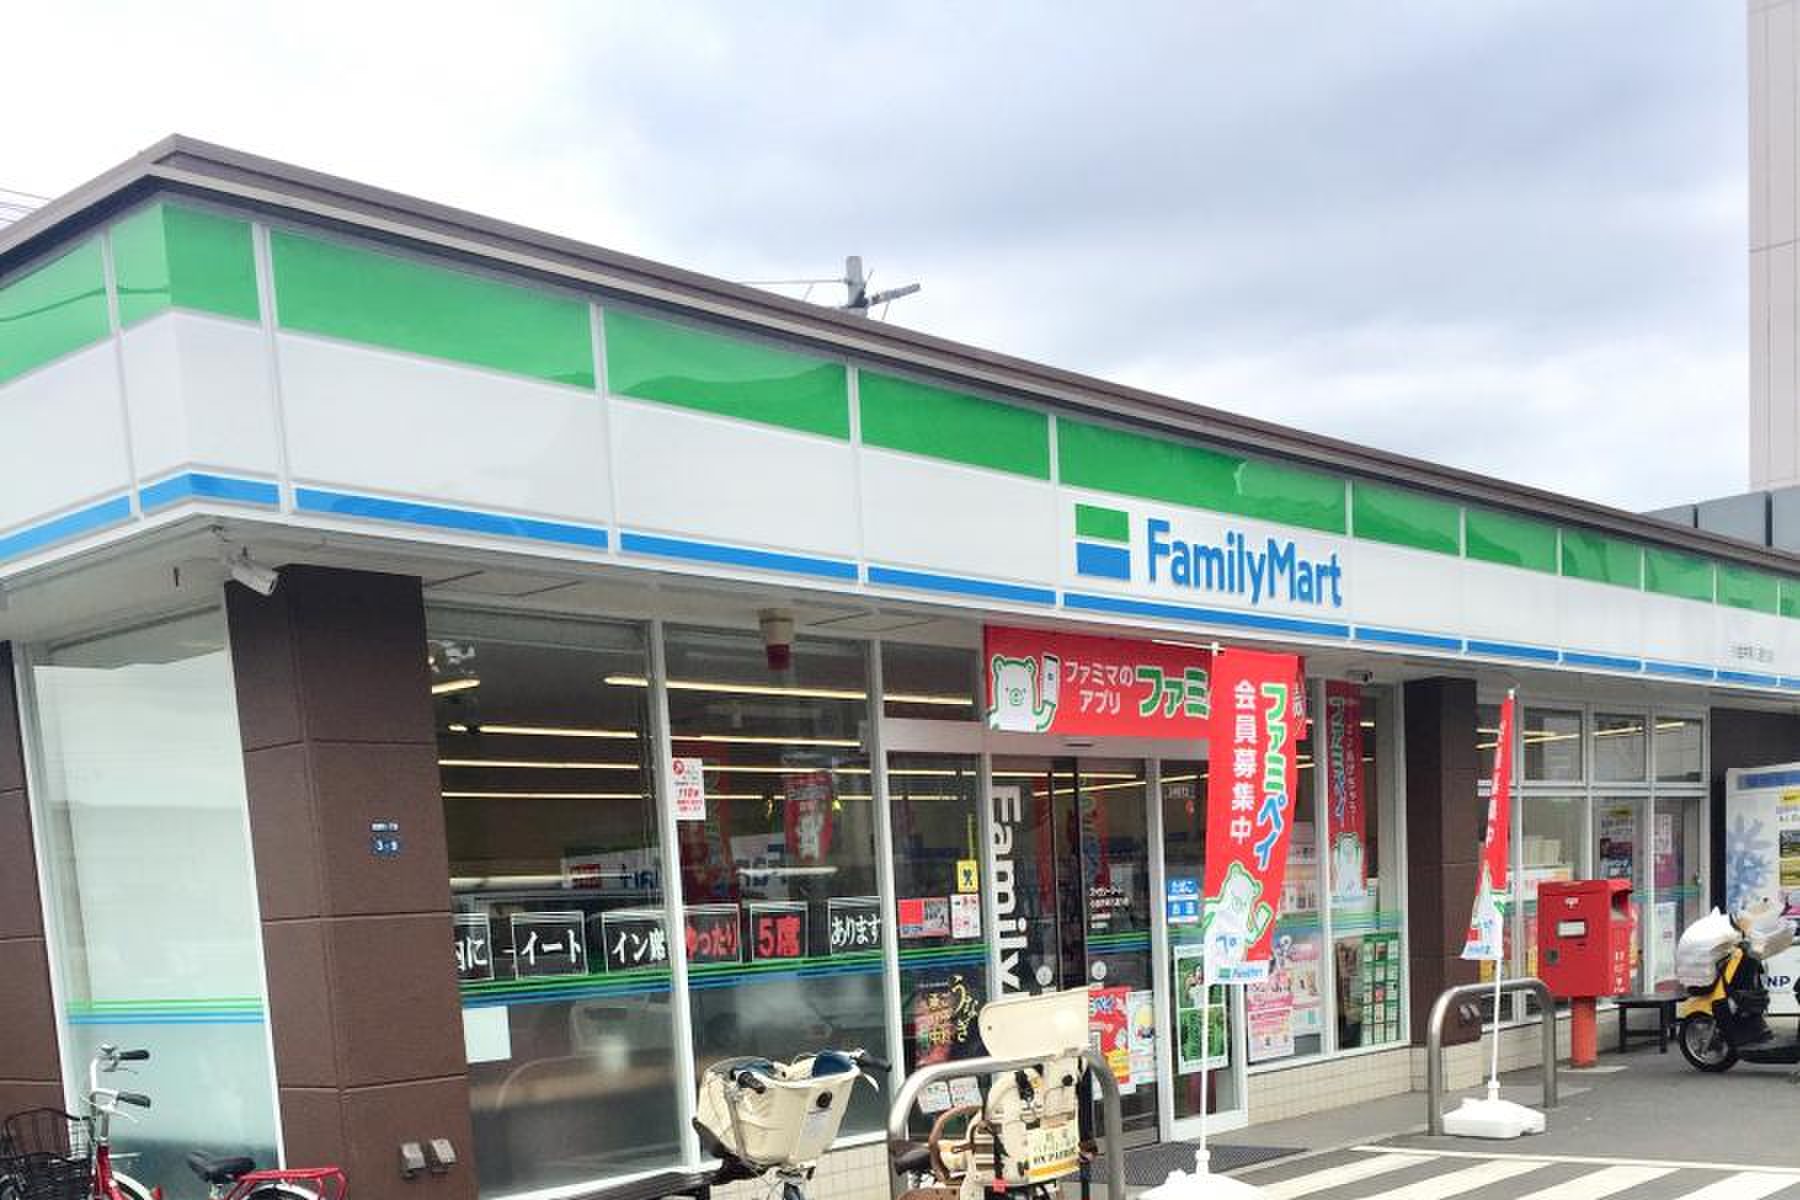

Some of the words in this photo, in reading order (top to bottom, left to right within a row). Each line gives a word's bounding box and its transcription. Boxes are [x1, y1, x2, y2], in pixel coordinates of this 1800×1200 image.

[1147, 517, 1342, 607] FamilyMart
[1064, 660, 1134, 688] ファミマの
[1135, 665, 1211, 720] ファミ
[1079, 689, 1120, 716] アプリ
[1229, 679, 1257, 845] 会員募集中
[1254, 681, 1288, 871] ファミペイ
[521, 928, 581, 966] イート
[832, 913, 881, 948] あります
